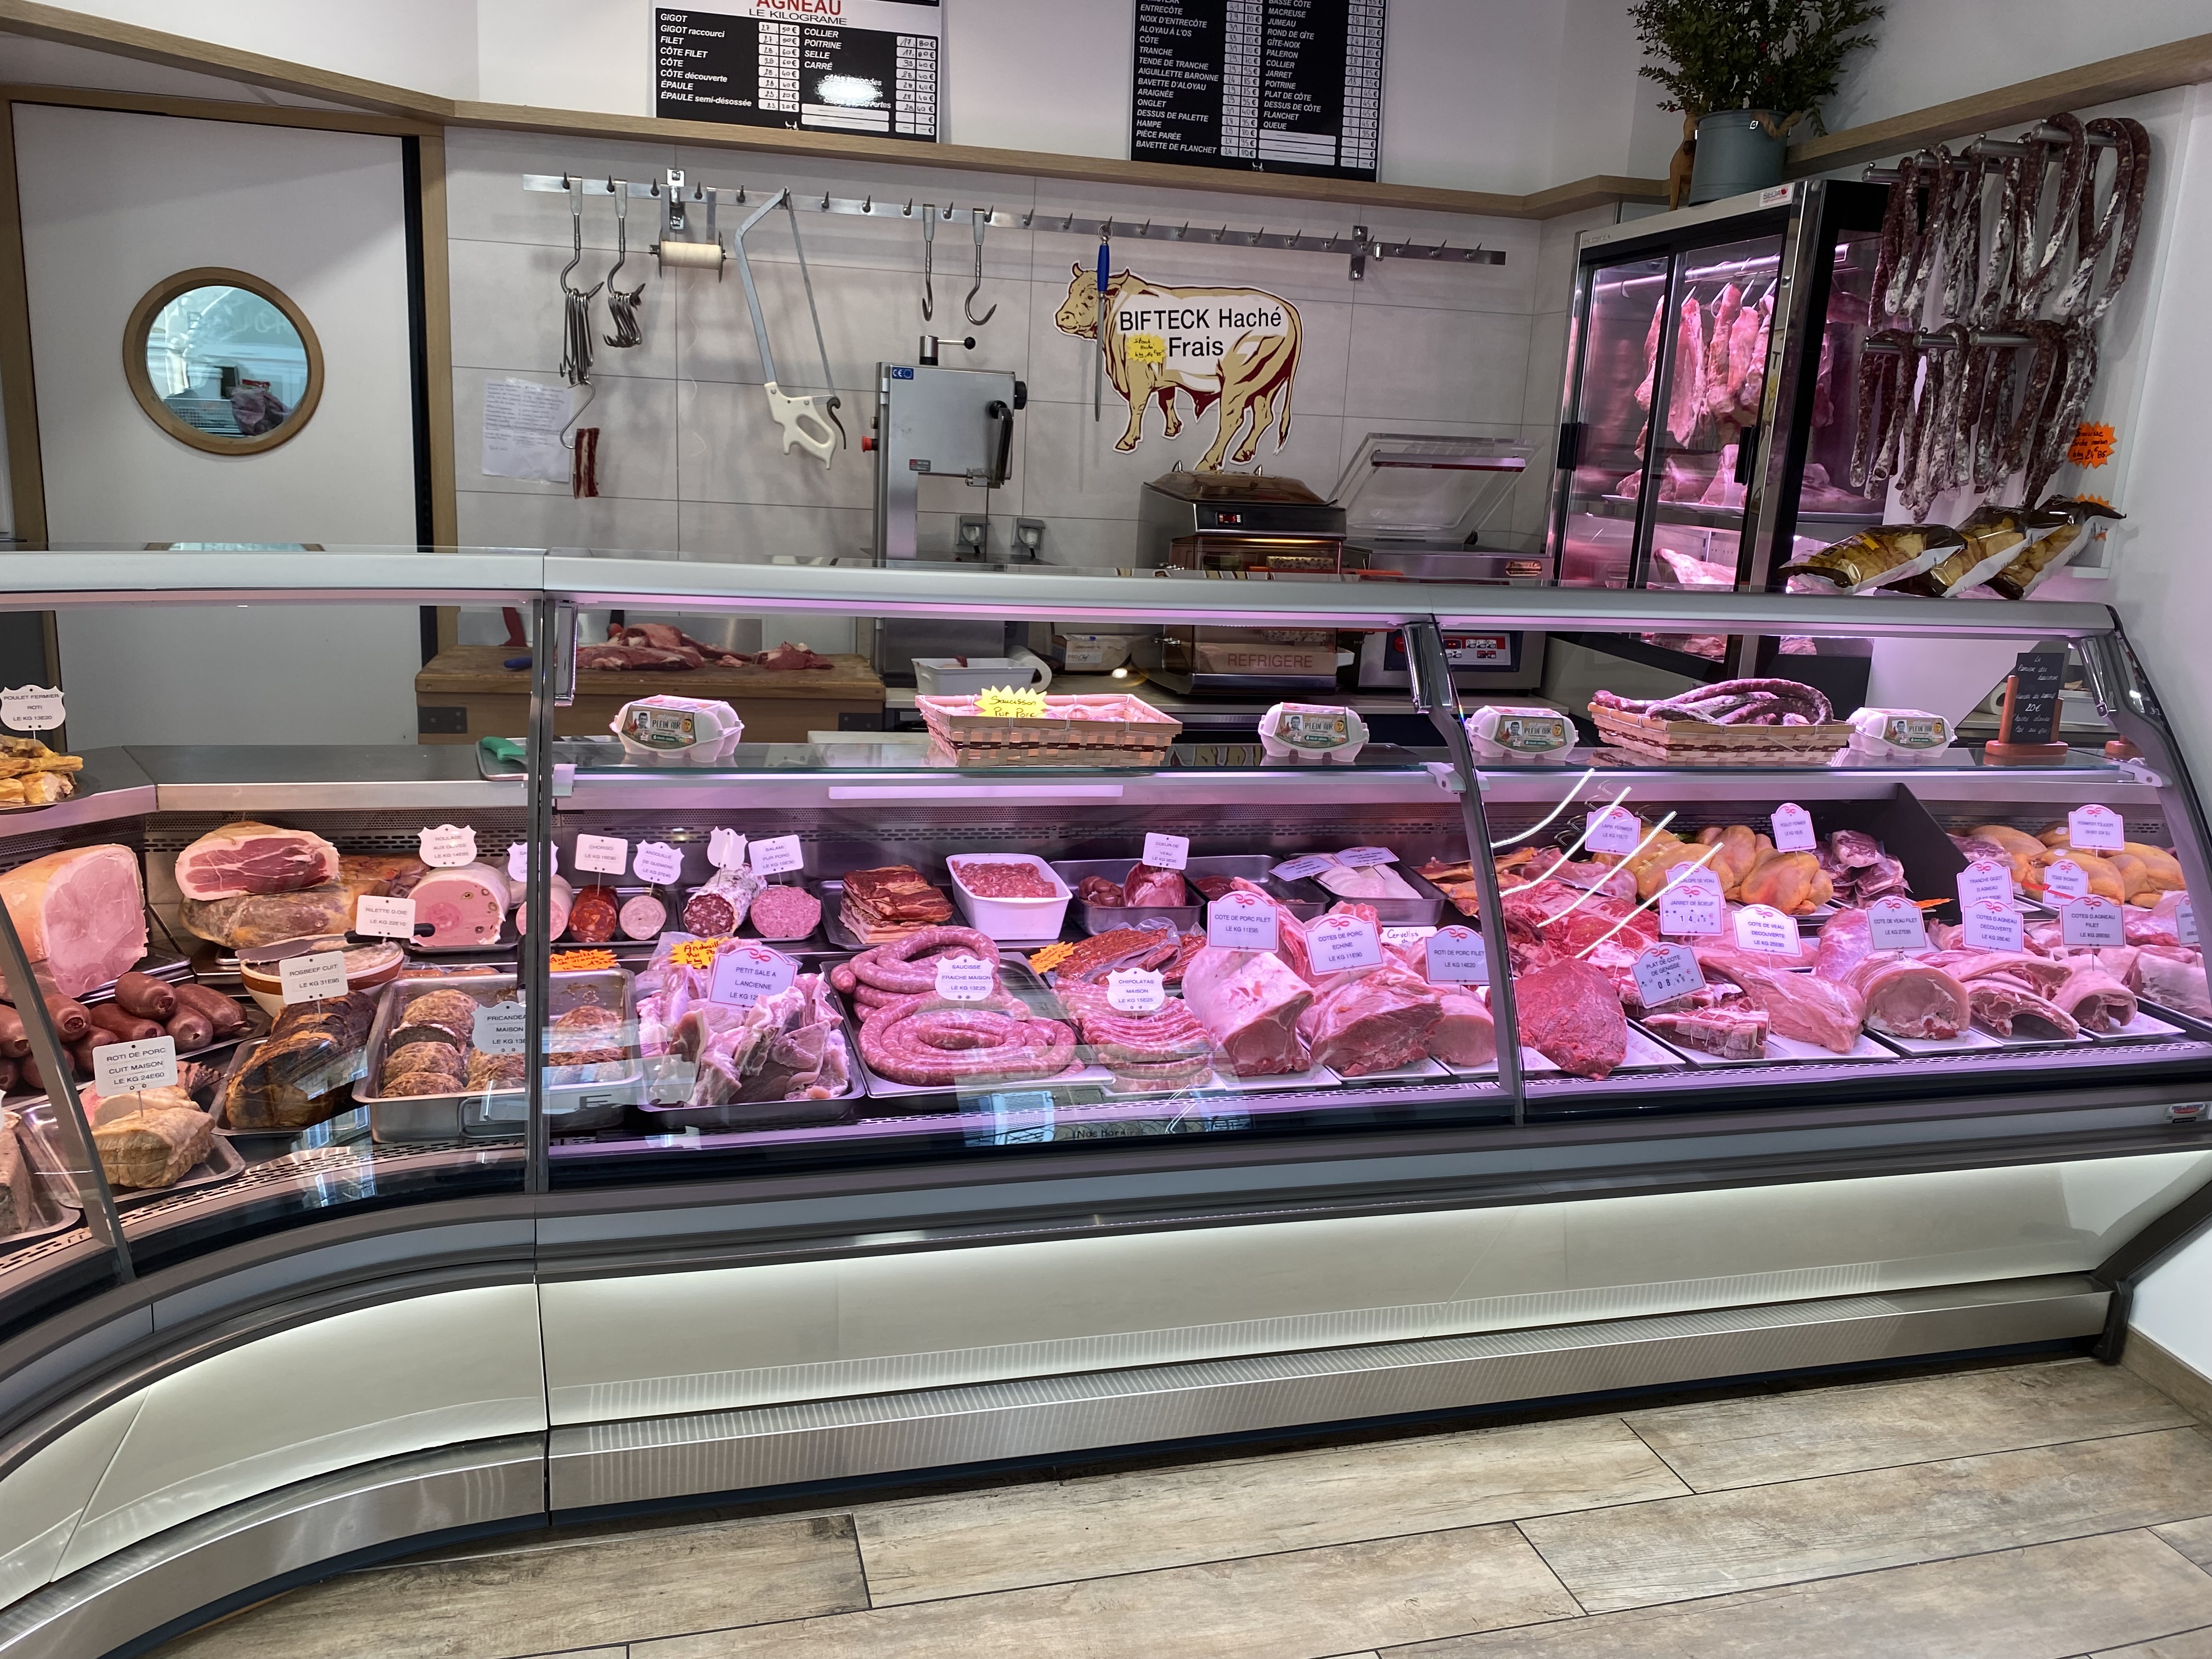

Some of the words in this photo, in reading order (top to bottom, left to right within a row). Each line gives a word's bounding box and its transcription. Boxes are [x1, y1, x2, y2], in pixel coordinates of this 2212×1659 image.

[1140, 4, 1183, 15] ENTRECÔTE
[1268, 7, 1306, 18] MACREUSE
[661, 13, 687, 22] GIGOT
[770, 11, 847, 25] KILOGRAME
[1140, 14, 1158, 22] NOIX
[1159, 16, 1207, 28] D'ENTRECÔTE
[1267, 18, 1296, 27] JUMEAU
[661, 25, 687, 33] GIGOT
[688, 29, 725, 37] raccourci
[804, 28, 839, 38] COLLIER
[1139, 25, 1169, 35] ALOYAU
[1176, 29, 1192, 37] L'OS
[1267, 28, 1287, 37] ROND
[660, 36, 684, 44] FILET
[804, 39, 842, 49] POITRINE
[1139, 35, 1159, 44] CÔTE
[660, 46, 683, 55] CÔTE
[685, 49, 708, 58] FILET
[804, 50, 831, 59] SELLE
[1139, 46, 1173, 56] TRANCHE
[1266, 49, 1299, 59] PALERON
[661, 57, 684, 67] CÔTE
[804, 61, 833, 70] CARRÉ
[1139, 57, 1163, 65] TENDE
[1176, 60, 1209, 70] TRANCHE
[1266, 59, 1295, 69] COLLIER
[661, 68, 684, 78] CÔTE
[685, 72, 727, 82] découverte
[1138, 67, 1183, 78] AIGUILLETTE
[1184, 72, 1219, 81] BARONNE
[1265, 70, 1293, 78] JARRET
[661, 79, 693, 90] ÉPAULE
[1138, 78, 1170, 87] BAVETTE
[1171, 81, 1206, 91] D'ALOYAU
[1265, 80, 1296, 89] POITRINE
[661, 90, 693, 101] ÉPAULE
[695, 95, 752, 106] semi-désossée
[1137, 88, 1174, 98] ARAIGNÉE
[1294, 92, 1312, 101] CÔTE
[1137, 99, 1166, 108] ONGLET
[1264, 100, 1291, 109] DESSUS
[1304, 104, 1321, 112] CÔTE
[1137, 109, 1165, 118] DESSUS
[1178, 113, 1209, 122] PALETTE
[1263, 111, 1299, 121] FLANCHET
[1136, 120, 1162, 128] HAMPE
[1263, 121, 1287, 129] QUEUE
[1136, 140, 1167, 149] BAVETTE
[1180, 144, 1217, 154] FLANCHET
[1120, 309, 1210, 331] BIFTECK
[1219, 306, 1282, 328] Haché
[1169, 336, 1224, 357] Frais
[1228, 653, 1313, 668] REFRIGERE
[652, 720, 668, 729] PLEIN
[645, 850, 672, 859] ANDOUILLE
[1980, 924, 2012, 932] DECOUVERTE
[290, 967, 320, 976] ROSBEEF
[1659, 963, 1680, 973] GENISSE
[109, 1066, 128, 1074] CUIT
[131, 1061, 163, 1070] MAISON
[140, 1072, 165, 1081] 24E60
